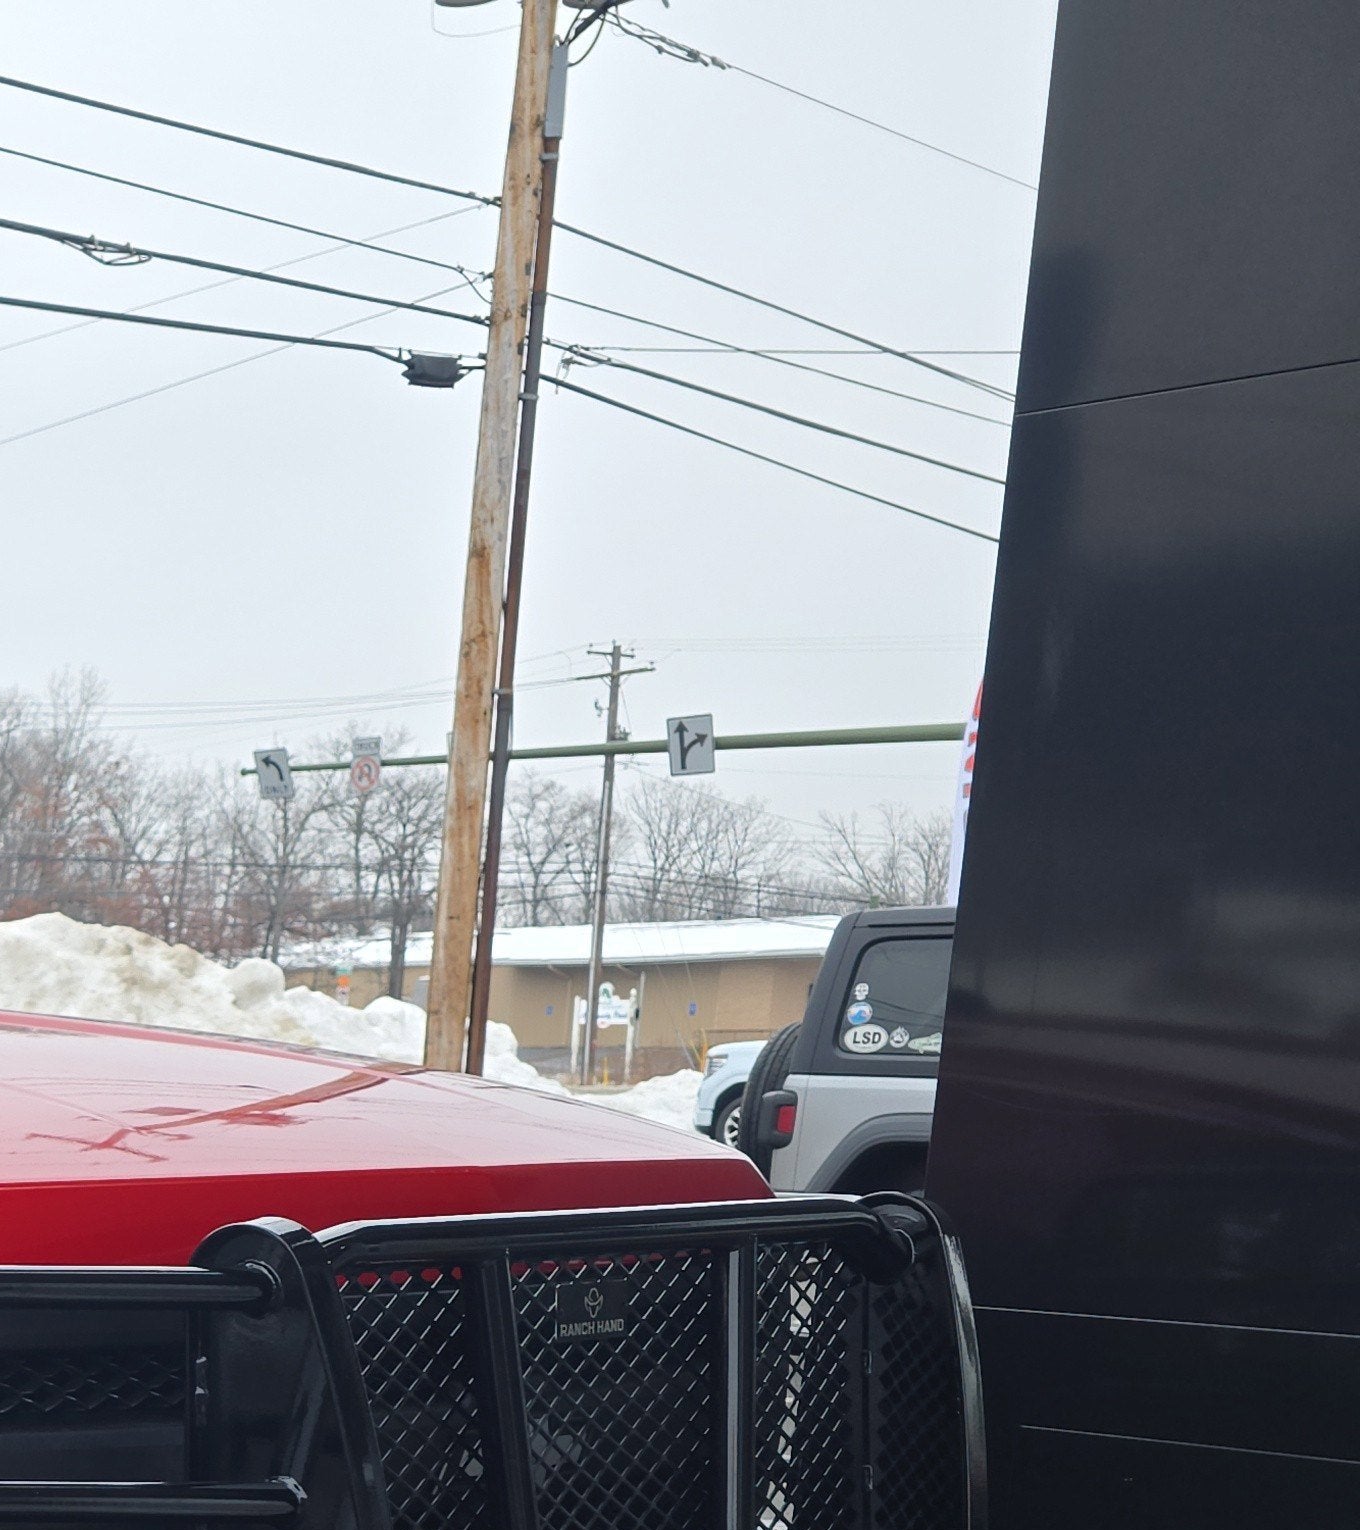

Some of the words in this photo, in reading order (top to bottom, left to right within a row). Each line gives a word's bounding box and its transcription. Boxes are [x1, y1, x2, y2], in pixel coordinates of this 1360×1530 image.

[853, 1031, 882, 1044] LSD
[560, 1321, 595, 1337] RANCH
[597, 1318, 625, 1333] HAND
